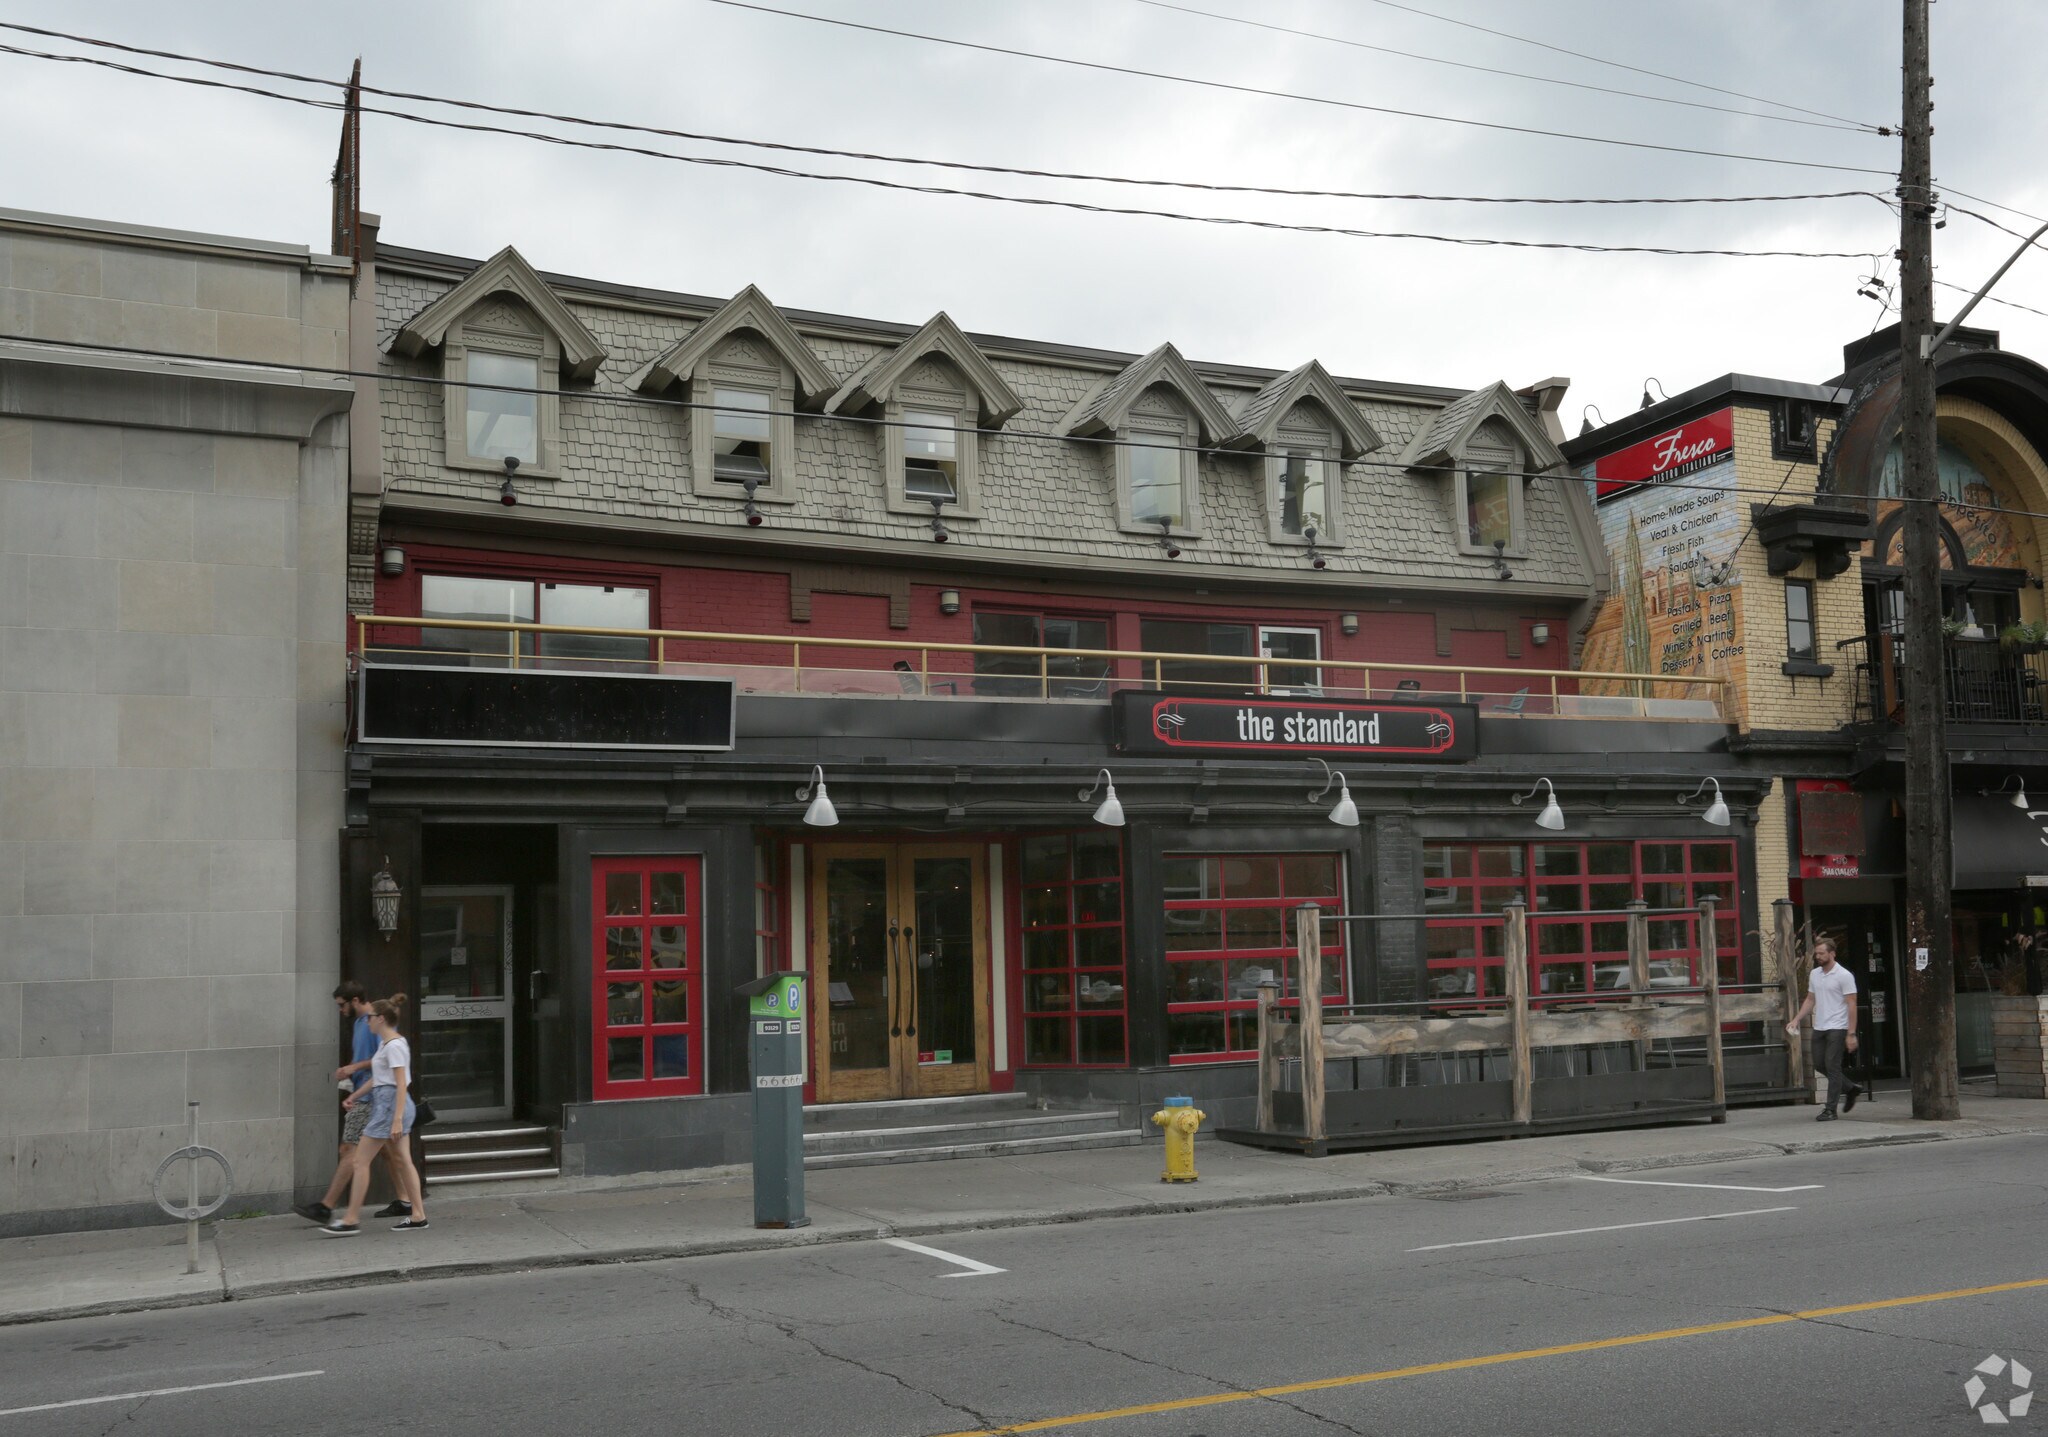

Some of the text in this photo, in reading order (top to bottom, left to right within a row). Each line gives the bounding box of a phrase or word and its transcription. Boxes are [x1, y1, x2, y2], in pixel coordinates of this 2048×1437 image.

[1653, 429, 1716, 472] Fresco
[1653, 453, 1716, 484] BISTRO ITALIANO
[1640, 490, 1725, 527] Home-Made Soups
[1650, 512, 1718, 541] Veal & Chicken
[1662, 535, 1704, 556] Fresh Fish
[1669, 557, 1699, 574] Salads
[1667, 592, 1731, 618] Pasta & Pizza
[1672, 609, 1730, 634] Grilled Beef
[1663, 629, 1734, 654] Wine & Martinis
[1662, 645, 1744, 672] Dessert & Coffee
[1237, 708, 1380, 744] the standard
